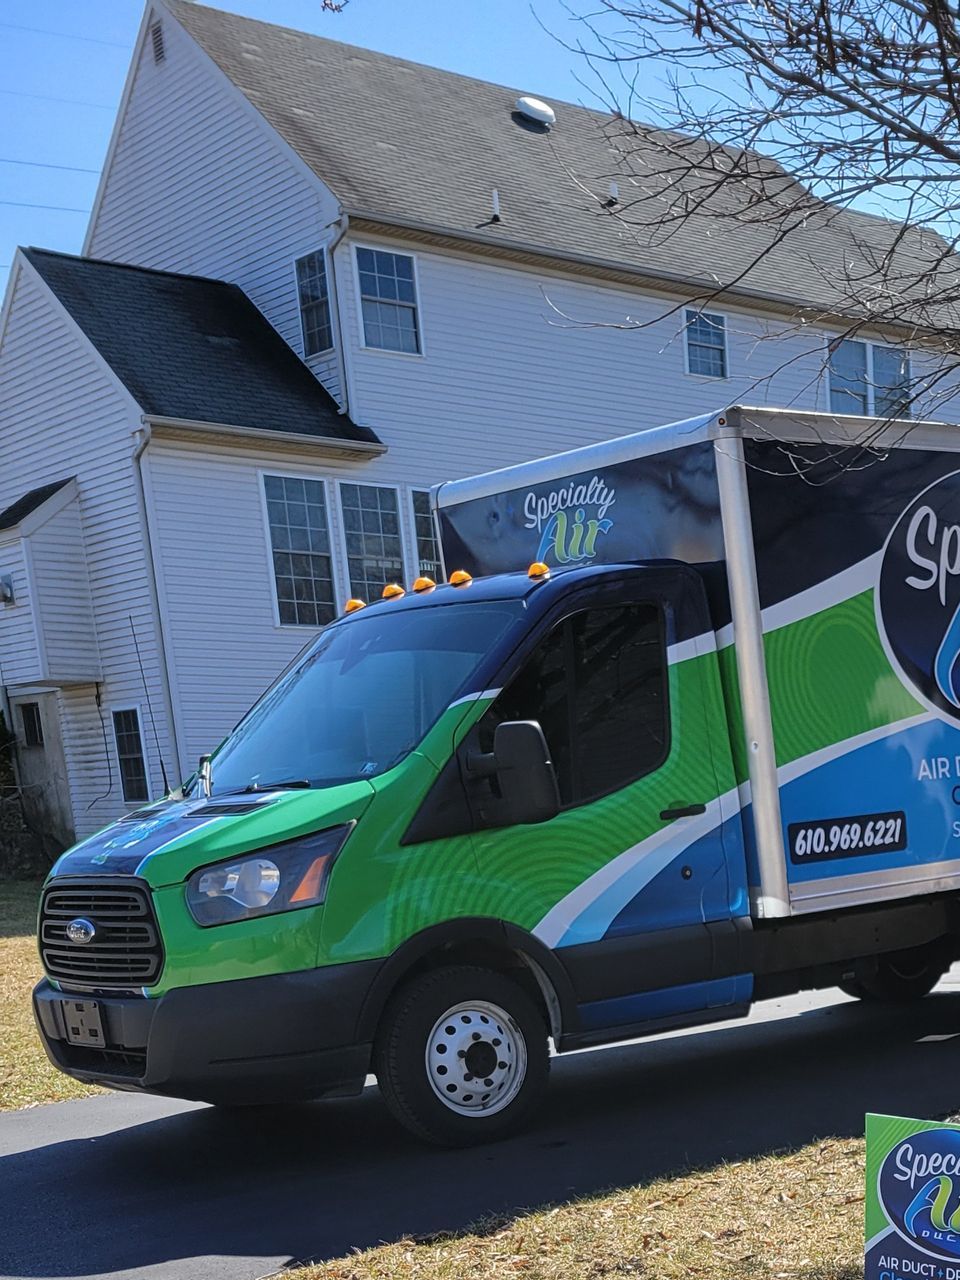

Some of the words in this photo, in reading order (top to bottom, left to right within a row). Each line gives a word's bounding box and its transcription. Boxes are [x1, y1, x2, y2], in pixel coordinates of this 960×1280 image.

[524, 476, 616, 534] Specialty
[536, 508, 614, 563] Air
[917, 757, 951, 781] AIR
[794, 818, 902, 856] 610.969.6221
[878, 1255, 899, 1270] AIR
[902, 1259, 936, 1278] DUCT
